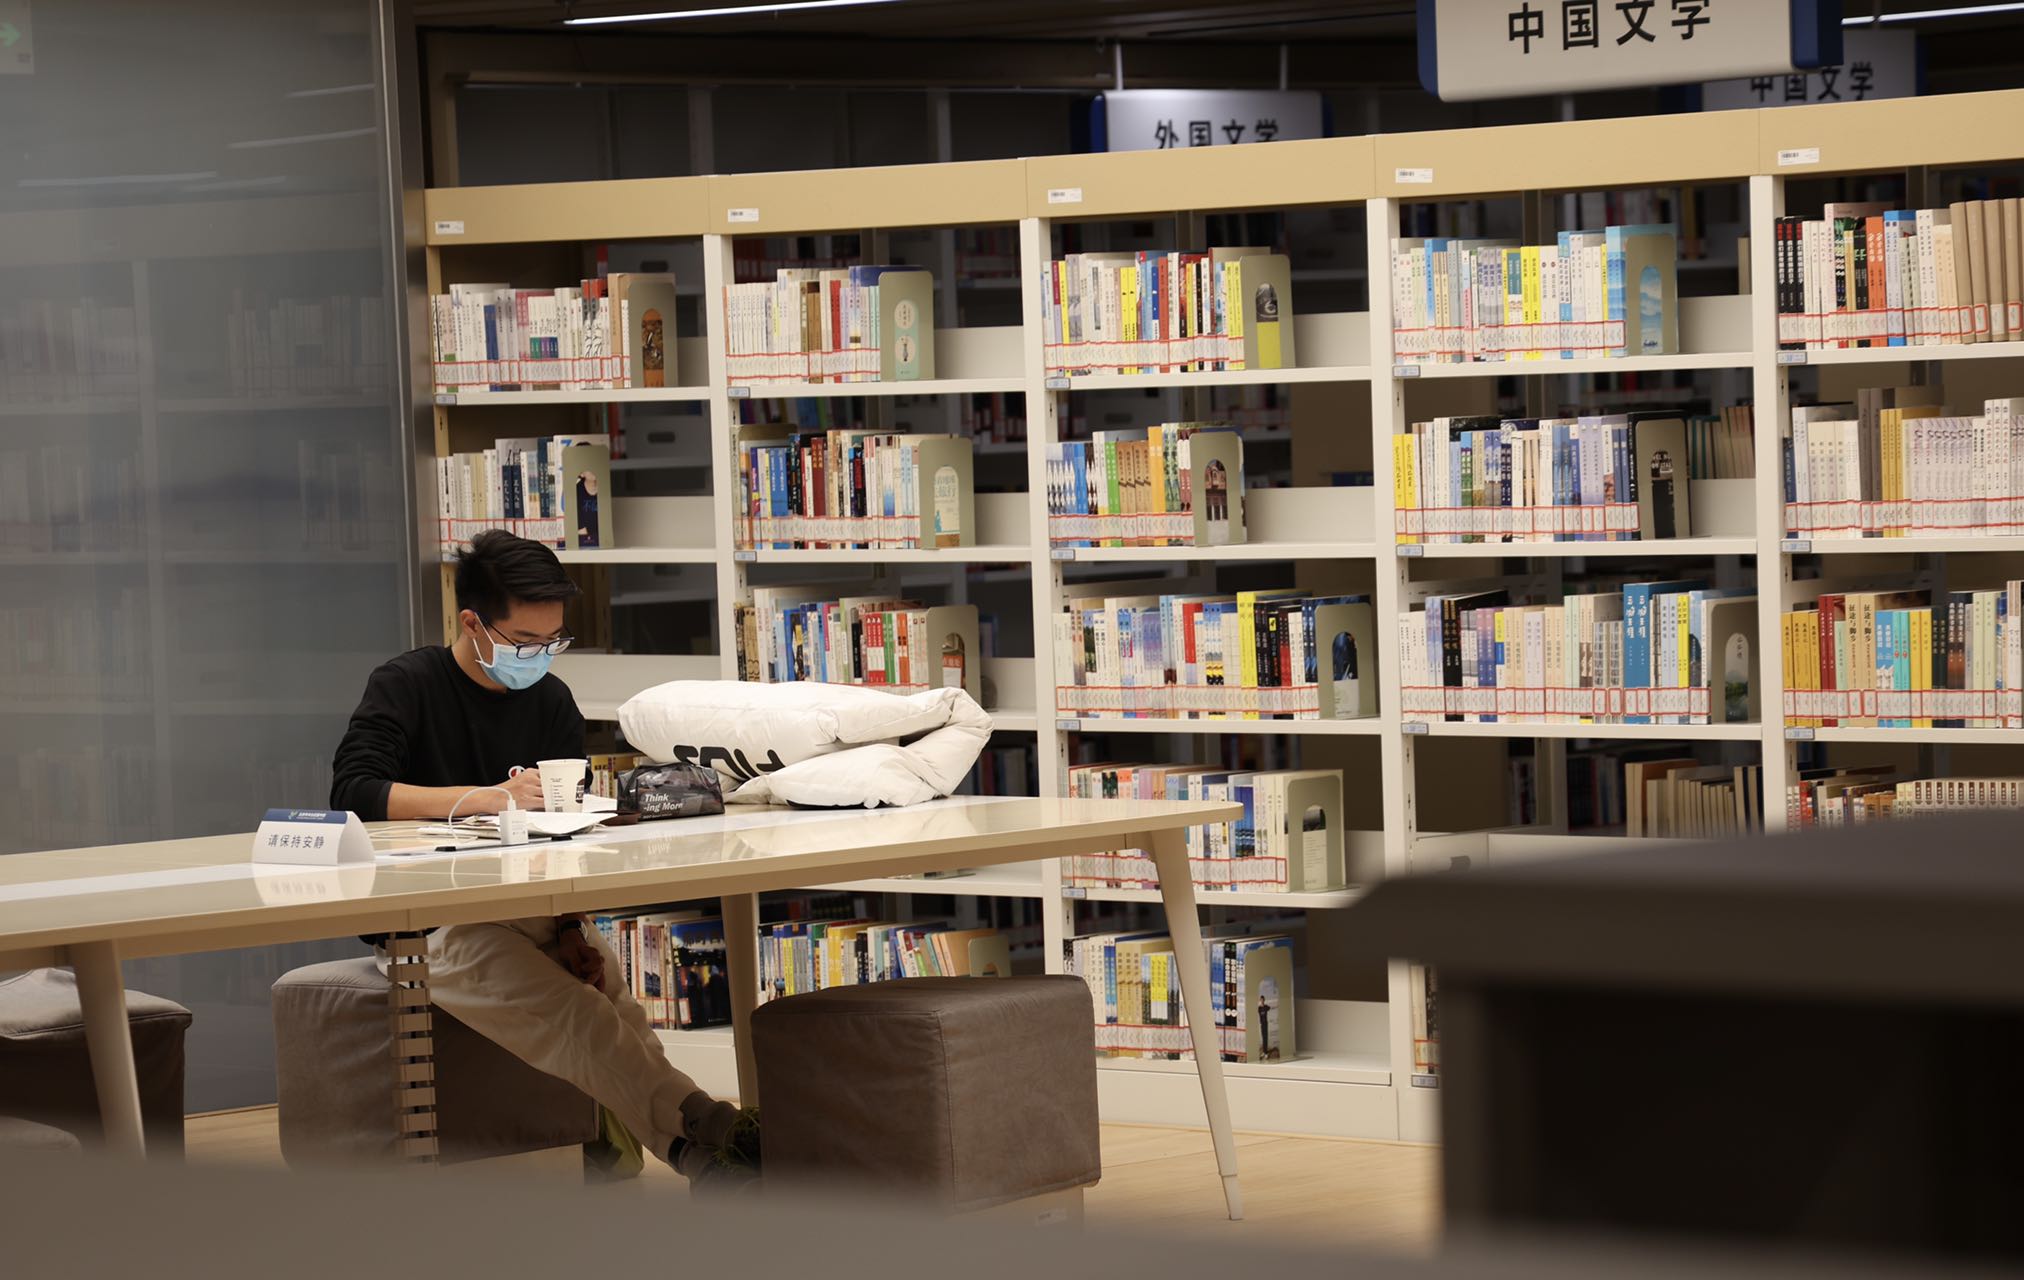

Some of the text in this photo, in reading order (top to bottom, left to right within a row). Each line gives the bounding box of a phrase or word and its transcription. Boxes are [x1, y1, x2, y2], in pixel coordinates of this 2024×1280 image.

[1508, 0, 1711, 54] 中国文学
[1750, 61, 1875, 102] 中国文学
[1155, 119, 1279, 149] 外国文学
[645, 793, 669, 802] Think
[268, 834, 325, 849] 请保持安静
